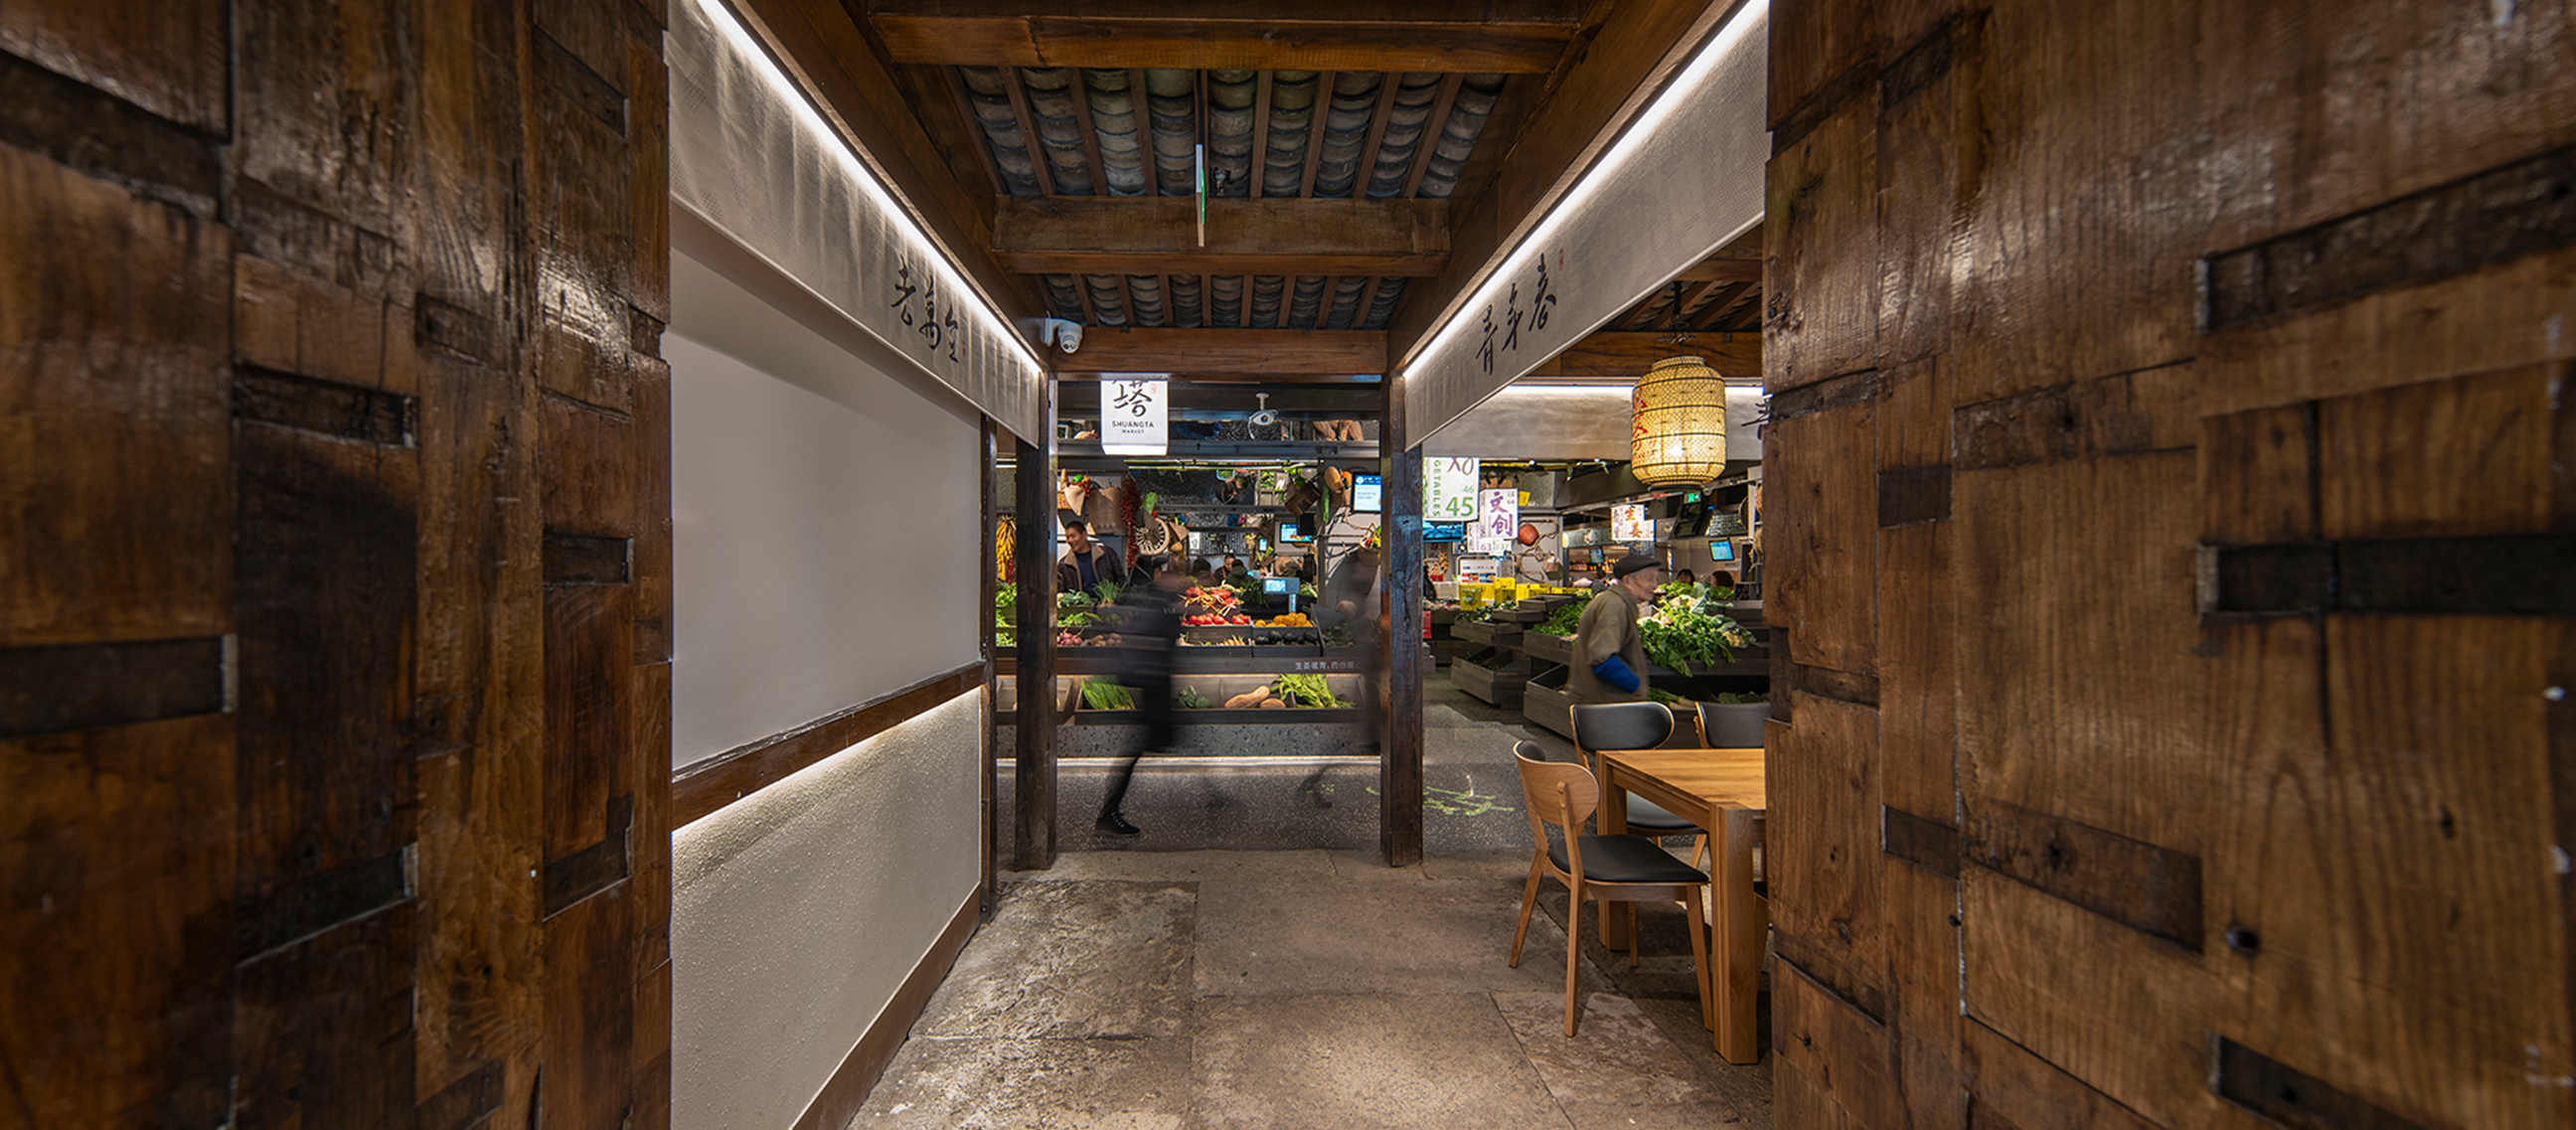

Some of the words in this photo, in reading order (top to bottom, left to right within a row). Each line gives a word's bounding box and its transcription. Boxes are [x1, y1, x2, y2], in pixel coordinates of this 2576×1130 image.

[1433, 459, 1442, 517] GETABLES
[1445, 496, 1474, 517] 45
[1490, 491, 1514, 537] 文创
